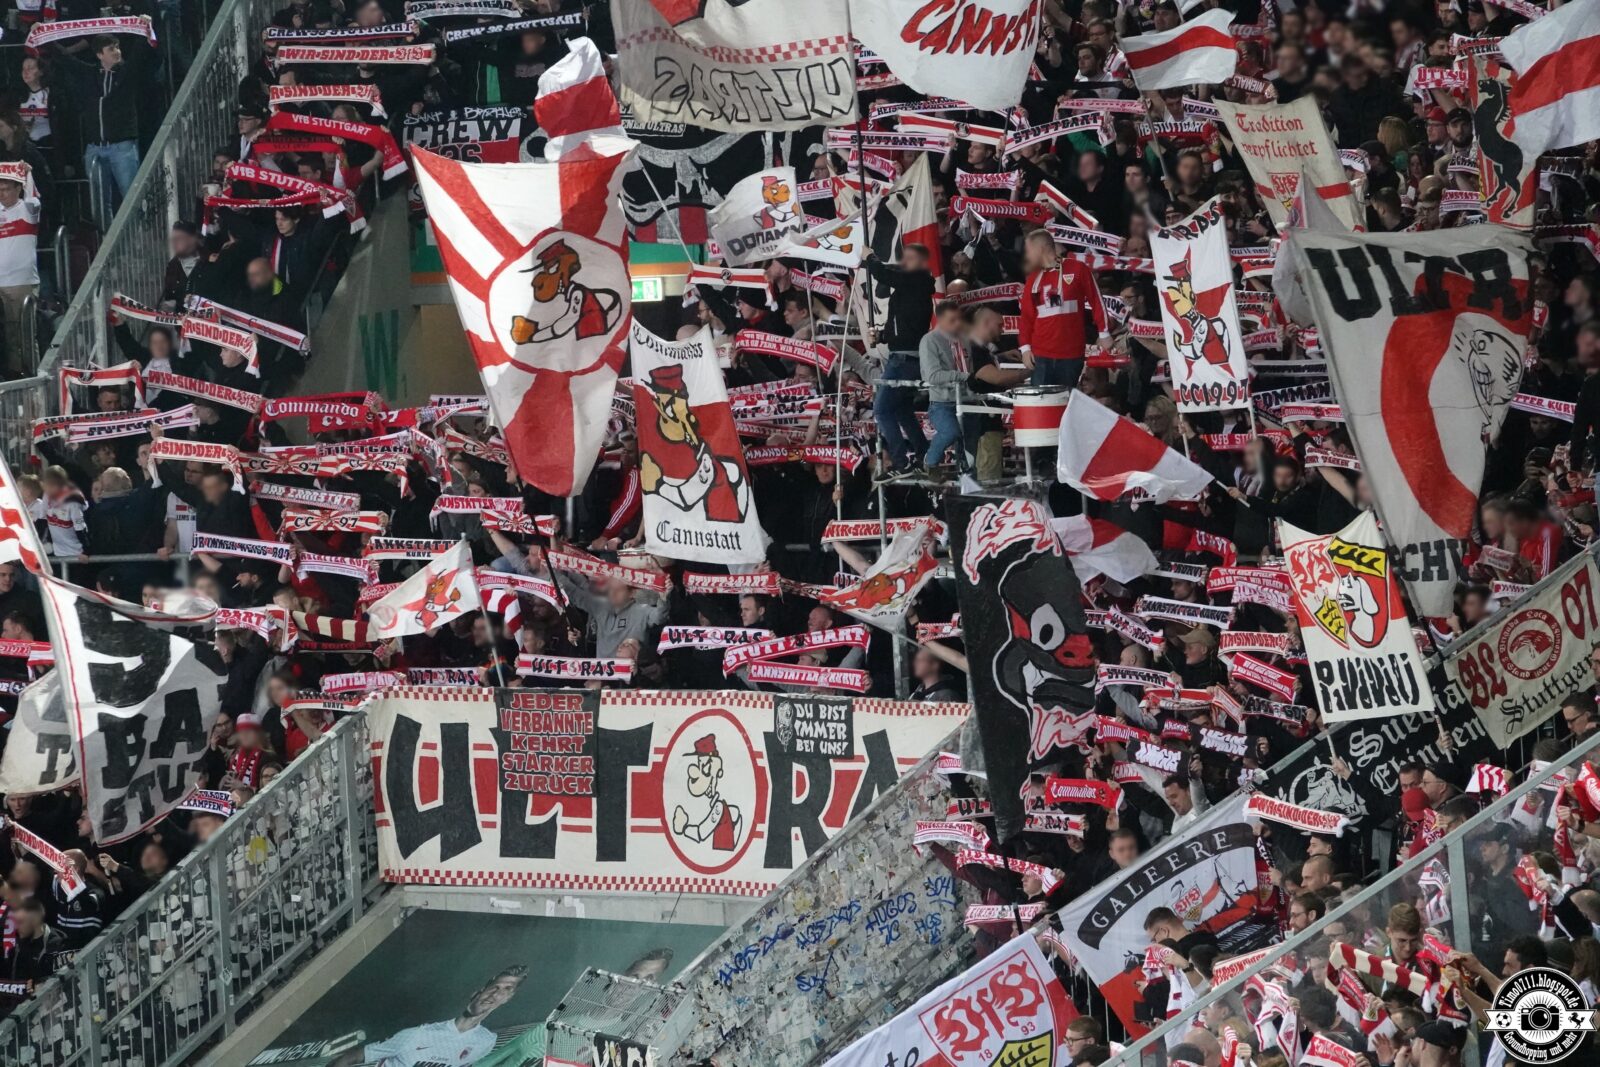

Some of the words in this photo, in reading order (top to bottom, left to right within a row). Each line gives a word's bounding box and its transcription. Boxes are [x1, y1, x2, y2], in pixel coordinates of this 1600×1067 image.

[444, 26, 483, 41] CREW
[505, 13, 581, 31] STUTTGART
[284, 48, 316, 60] WIR
[320, 48, 356, 60] SIND
[360, 48, 389, 60] DER
[1231, 76, 1266, 93] NIEMALS
[291, 113, 310, 124] VfB
[312, 117, 371, 136] STUTTGART
[648, 122, 684, 134] ULTRAS
[1013, 112, 1101, 144] STUTTGART
[1237, 112, 1304, 132] Tradition
[406, 119, 520, 148] CREW
[1241, 139, 1319, 160] verpflichtet
[231, 165, 256, 180] VfB
[148, 370, 173, 386] WIR
[178, 375, 205, 393] SIND
[208, 382, 232, 399] DER
[1180, 378, 1248, 406] CC1997
[265, 398, 359, 418] Commando
[160, 442, 191, 457] SIND
[194, 444, 221, 458] DER
[298, 462, 320, 473] 97
[293, 516, 312, 528] CC
[339, 517, 359, 528] 97
[656, 519, 742, 551] Cannstatt
[1561, 563, 1600, 640] 07
[532, 657, 615, 676] ULTRAS
[511, 693, 584, 711] JEDER
[794, 703, 814, 719] DU
[819, 704, 847, 721] BIST
[500, 710, 593, 735] VERBANNTE
[794, 720, 847, 740] IMMER
[511, 734, 584, 752] KEHRT
[796, 739, 815, 752] BEI
[819, 740, 846, 756] UNS!
[503, 752, 594, 774] STÄRKER
[504, 772, 593, 794] ZURÜCK
[1091, 831, 1236, 929] GALEERE
[979, 1048, 993, 1063] 18
[1021, 1022, 1036, 1036] 93
